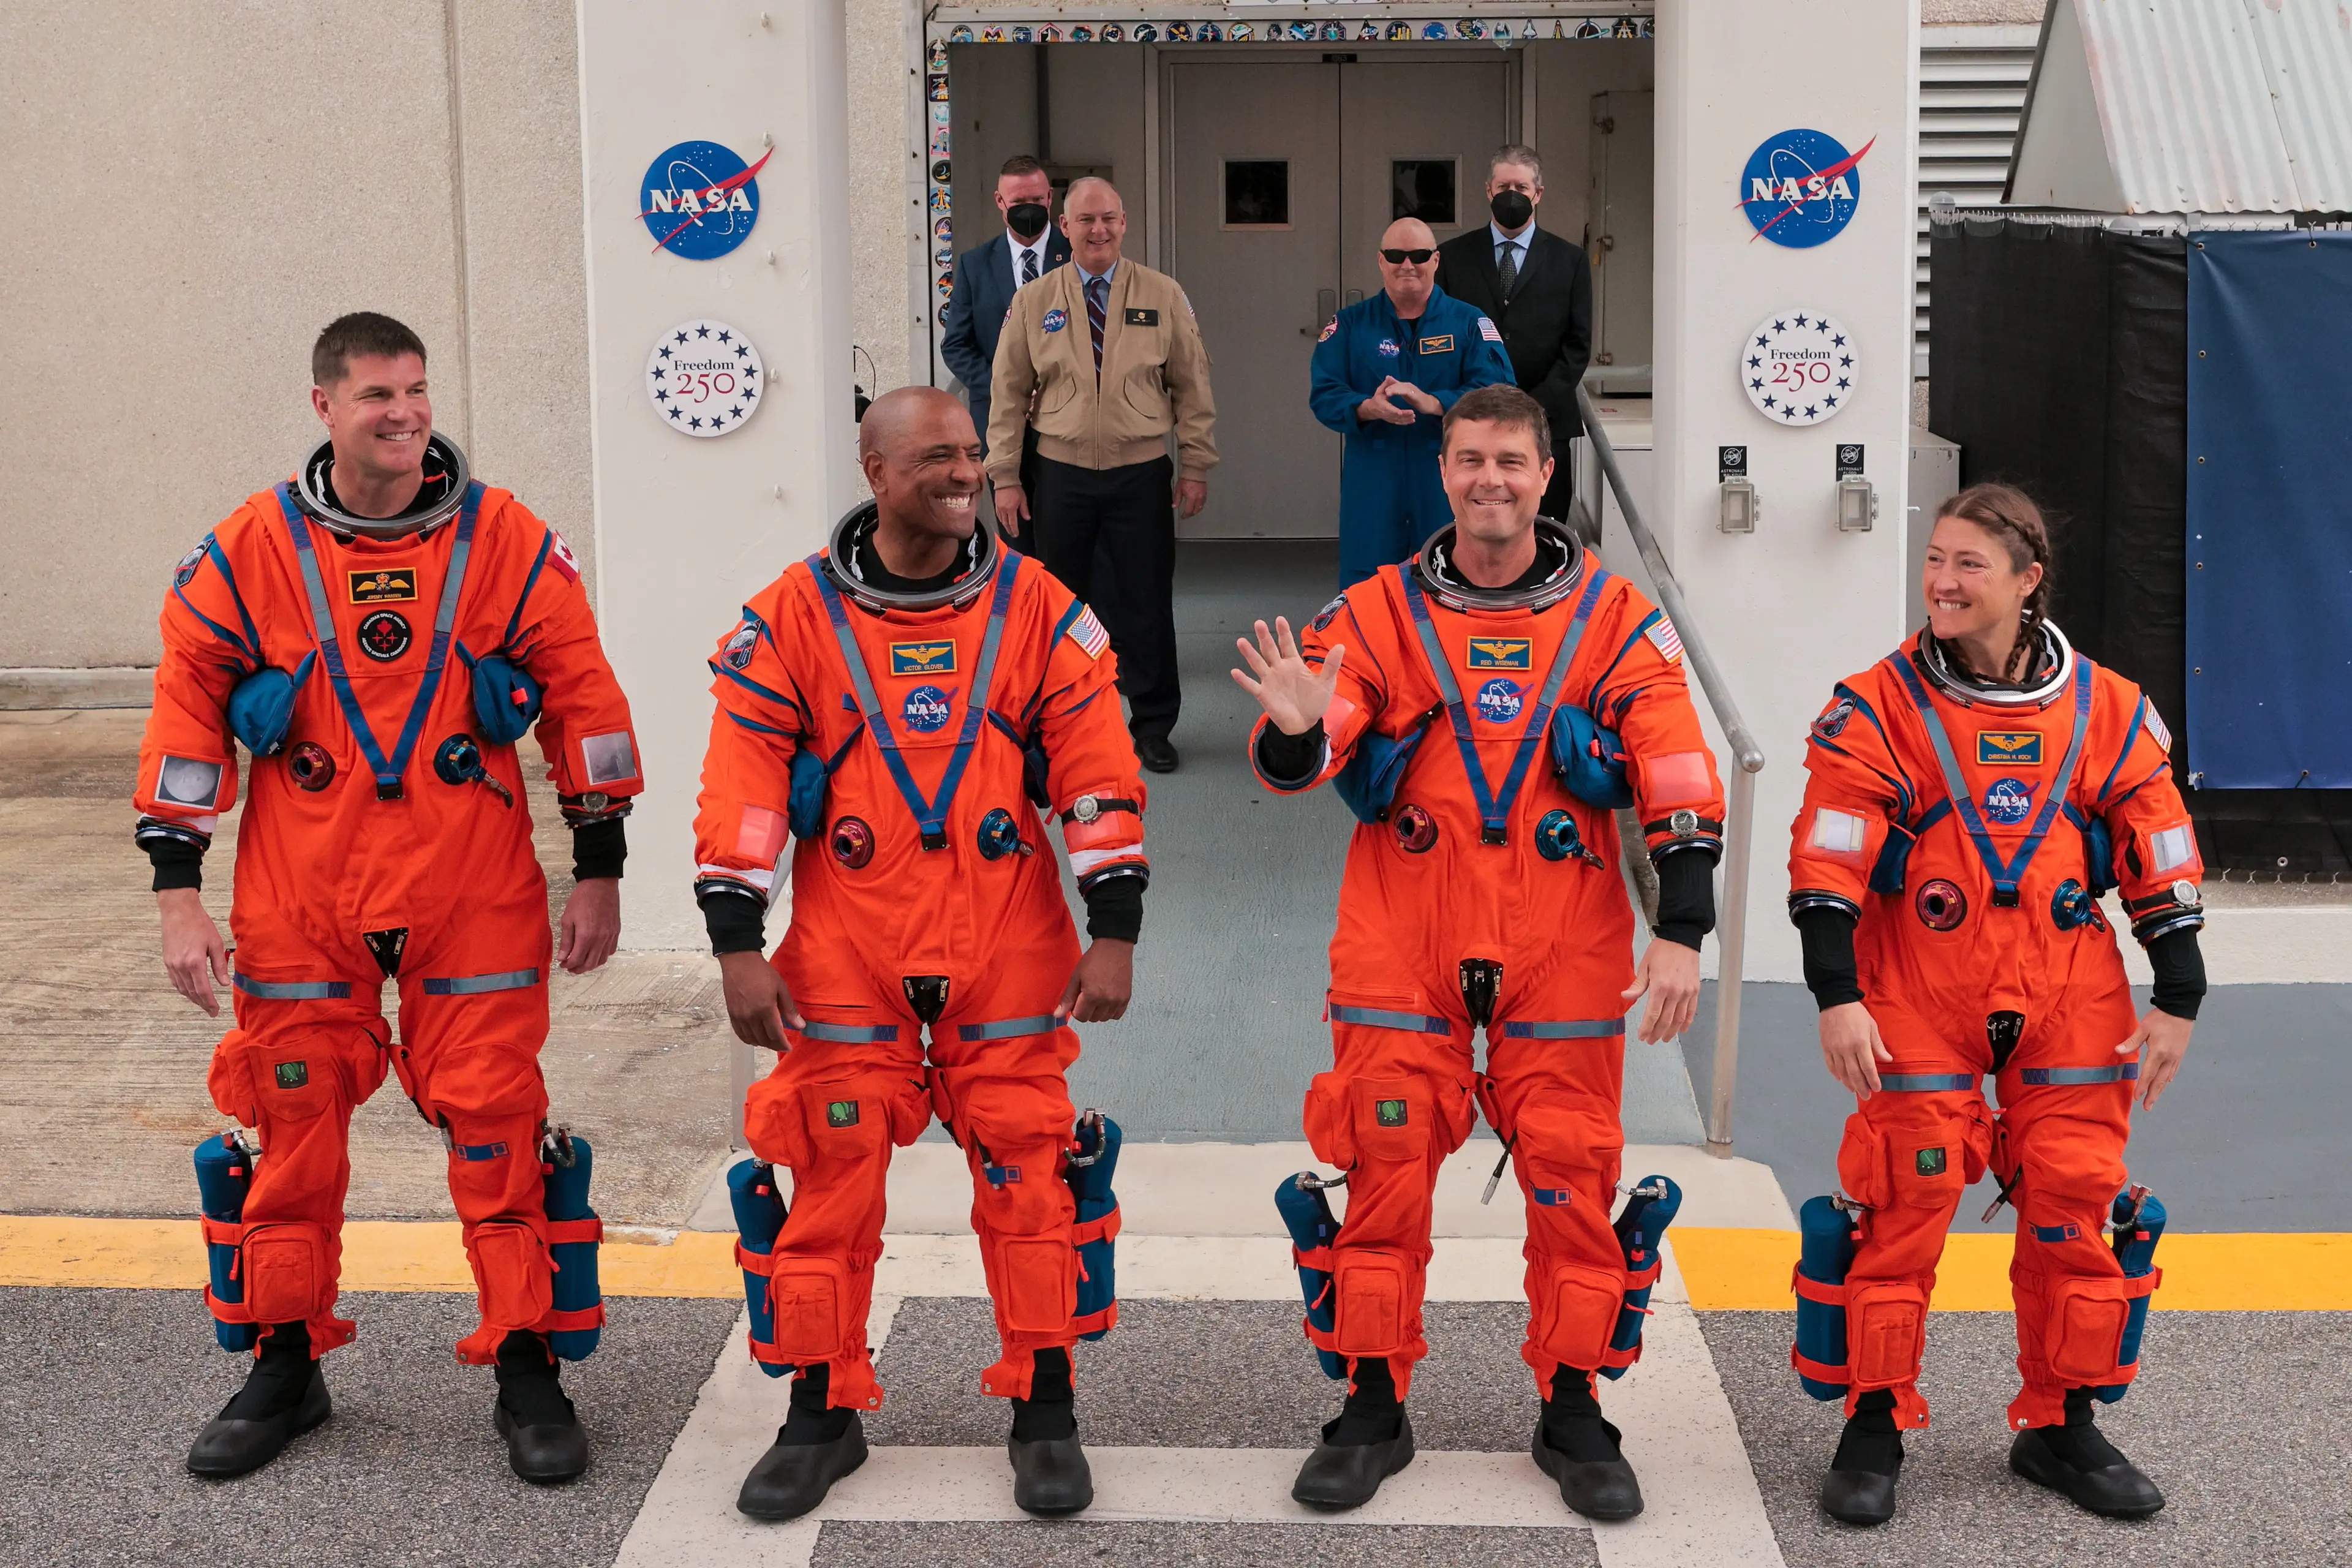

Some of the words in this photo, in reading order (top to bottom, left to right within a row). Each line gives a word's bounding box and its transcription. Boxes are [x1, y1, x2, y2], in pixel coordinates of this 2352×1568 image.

[1751, 176, 1854, 202] NASA
[649, 188, 753, 213] NASA
[1044, 316, 1065, 325] NASA
[1379, 343, 1400, 353] NASA
[1770, 348, 1831, 360] Freedom
[674, 360, 734, 371] Freedom
[1771, 361, 1831, 393] 250
[676, 372, 735, 403] 250
[363, 614, 380, 630] CANADIAN
[393, 616, 407, 629] AGENCY
[1480, 693, 1520, 707] NASA
[907, 704, 948, 715] NASA
[1988, 795, 2029, 807] NASA
